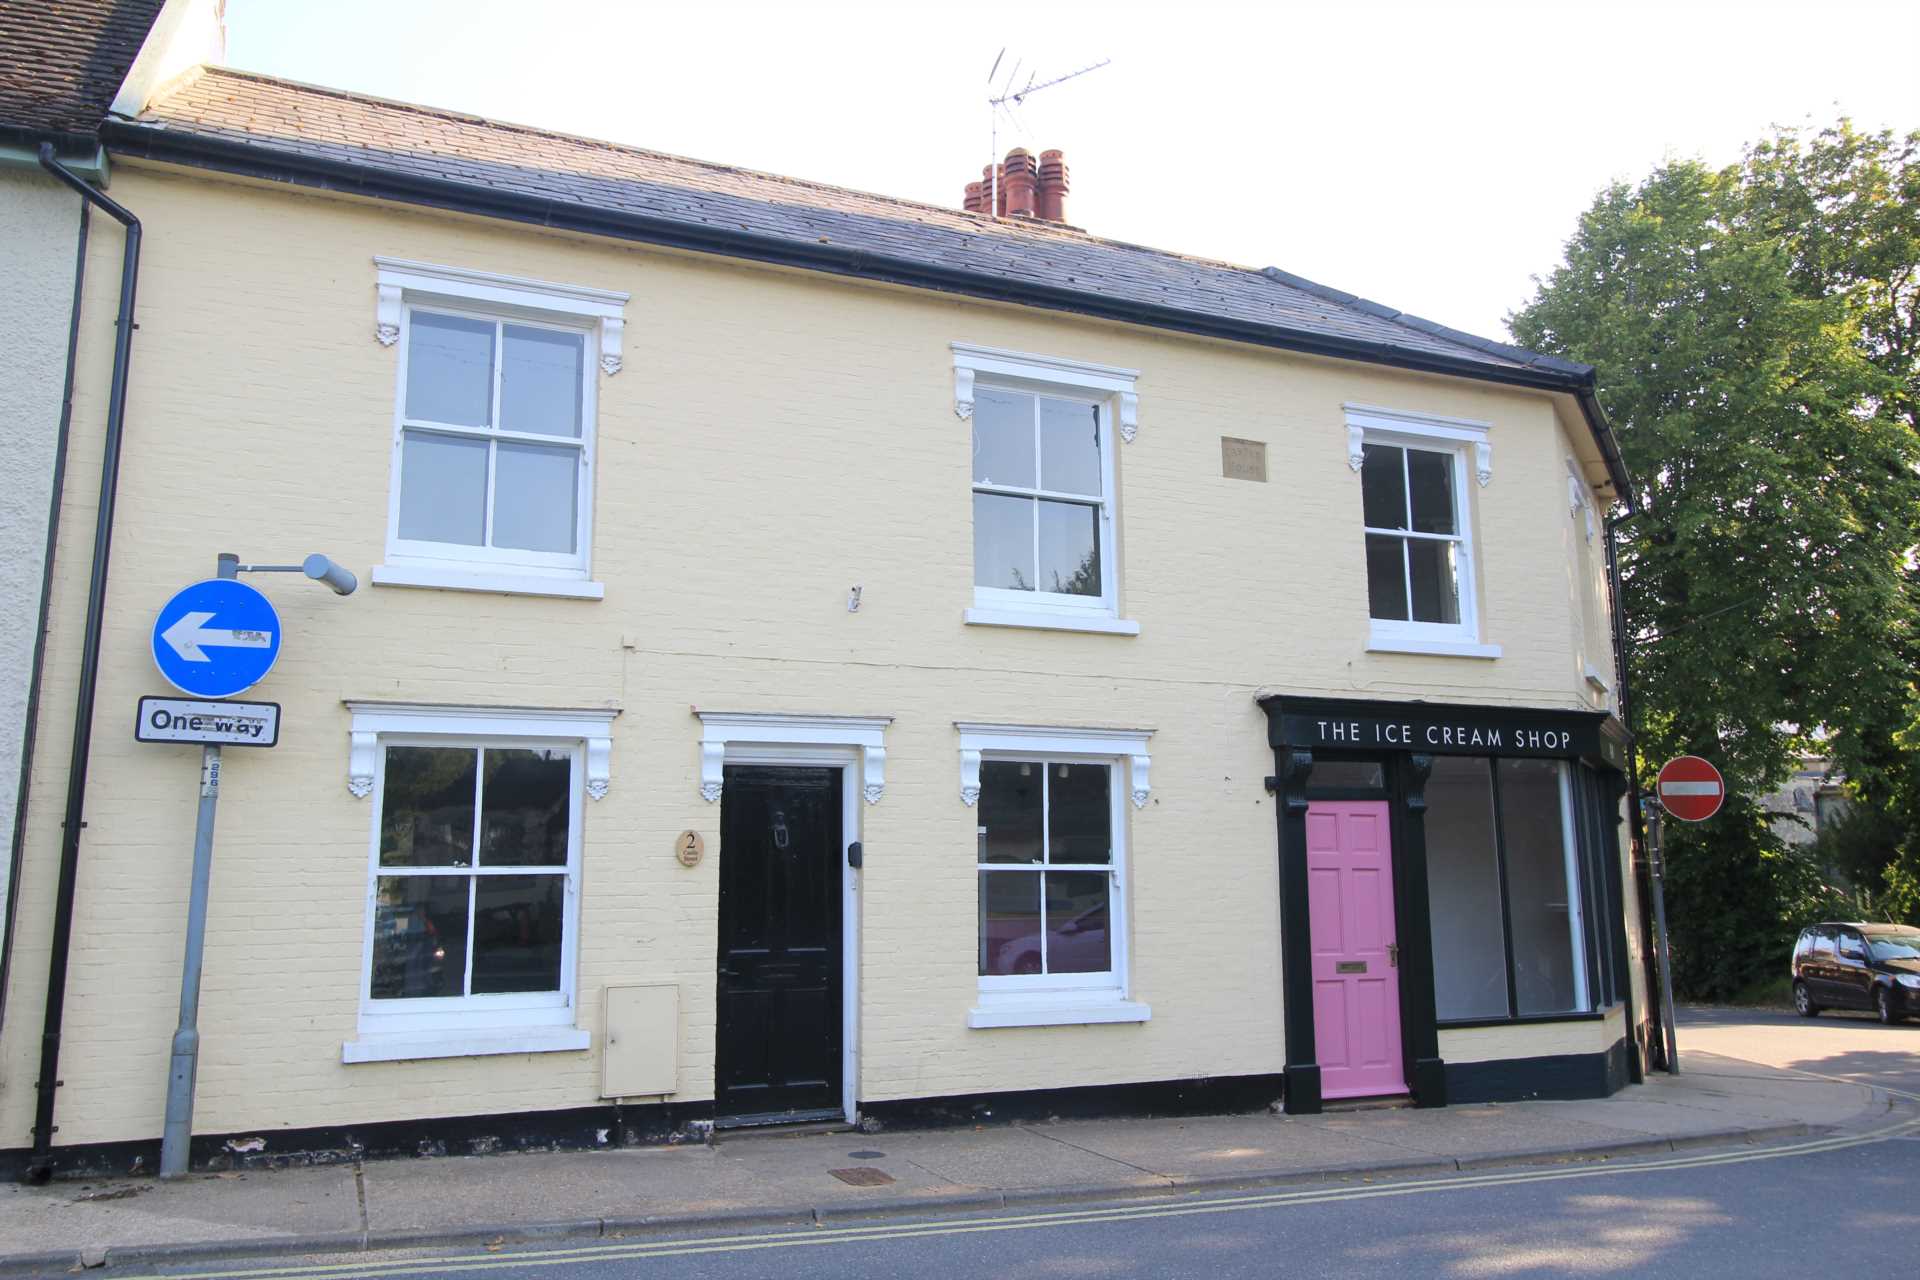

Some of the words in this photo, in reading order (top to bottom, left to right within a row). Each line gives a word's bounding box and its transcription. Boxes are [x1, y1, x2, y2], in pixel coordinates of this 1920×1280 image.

[151, 709, 203, 731] One
[215, 718, 264, 738] way
[1317, 721, 1360, 741] THE
[1375, 723, 1412, 743] ICE
[1426, 726, 1502, 747] CREAM
[1515, 729, 1570, 750] SHOP
[686, 833, 696, 849] 2
